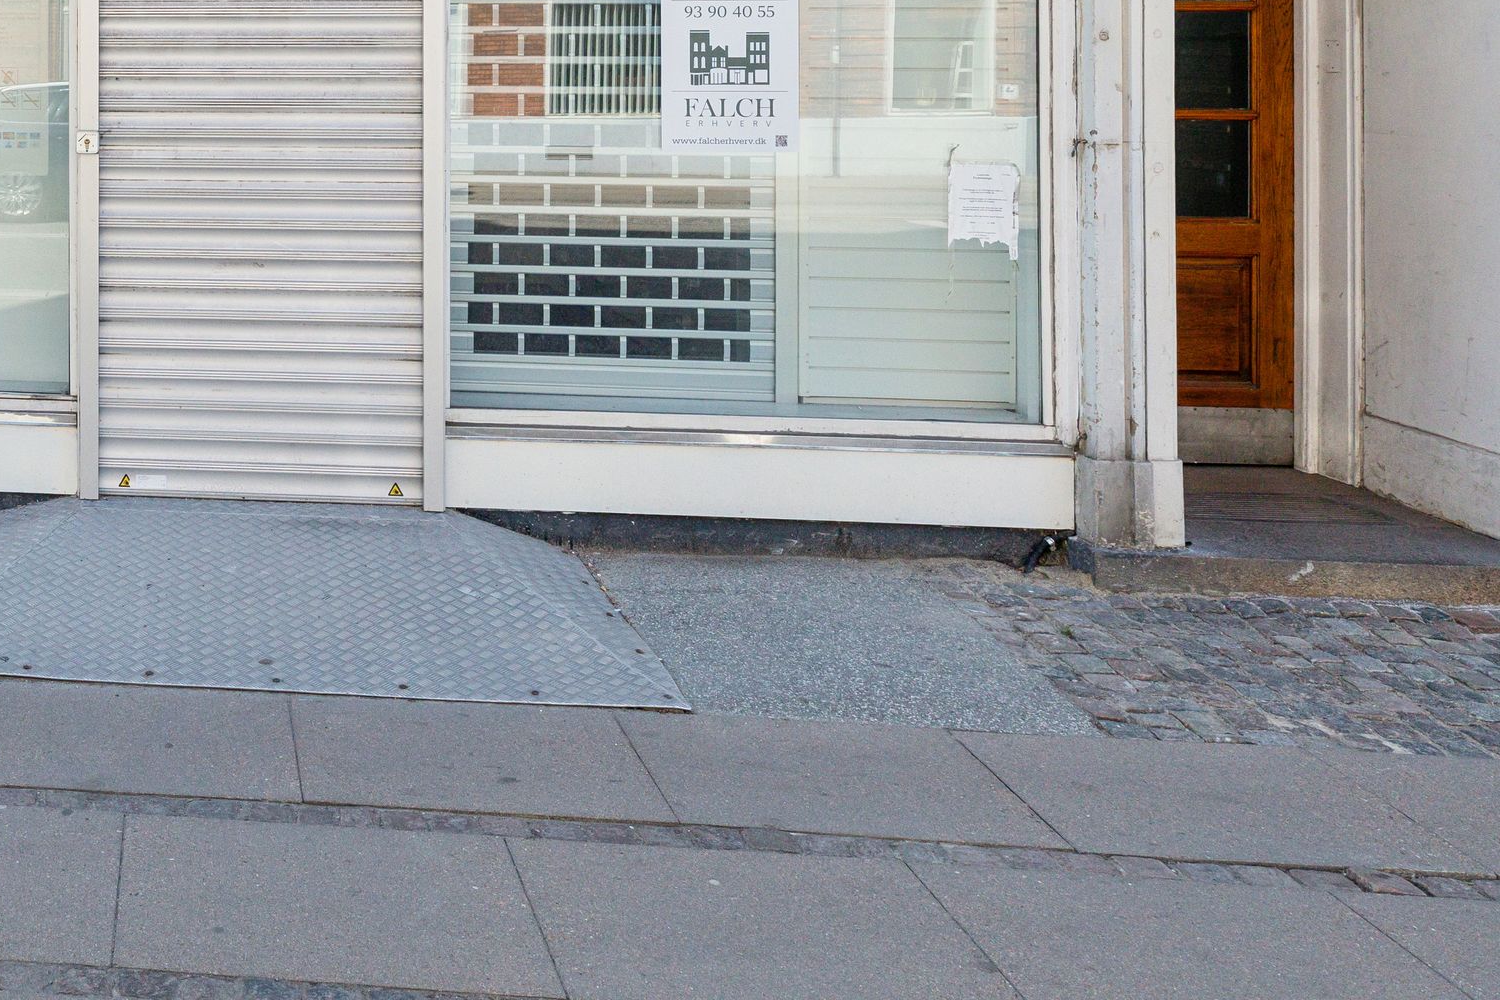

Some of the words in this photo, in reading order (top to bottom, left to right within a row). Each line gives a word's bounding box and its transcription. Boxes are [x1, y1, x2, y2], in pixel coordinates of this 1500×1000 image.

[684, 5, 703, 18] 93
[707, 5, 728, 18] 90
[732, 5, 753, 18] 40
[757, 5, 775, 18] 55
[684, 98, 776, 118] FALCH
[671, 136, 767, 145] www.falcherhverv.dk
